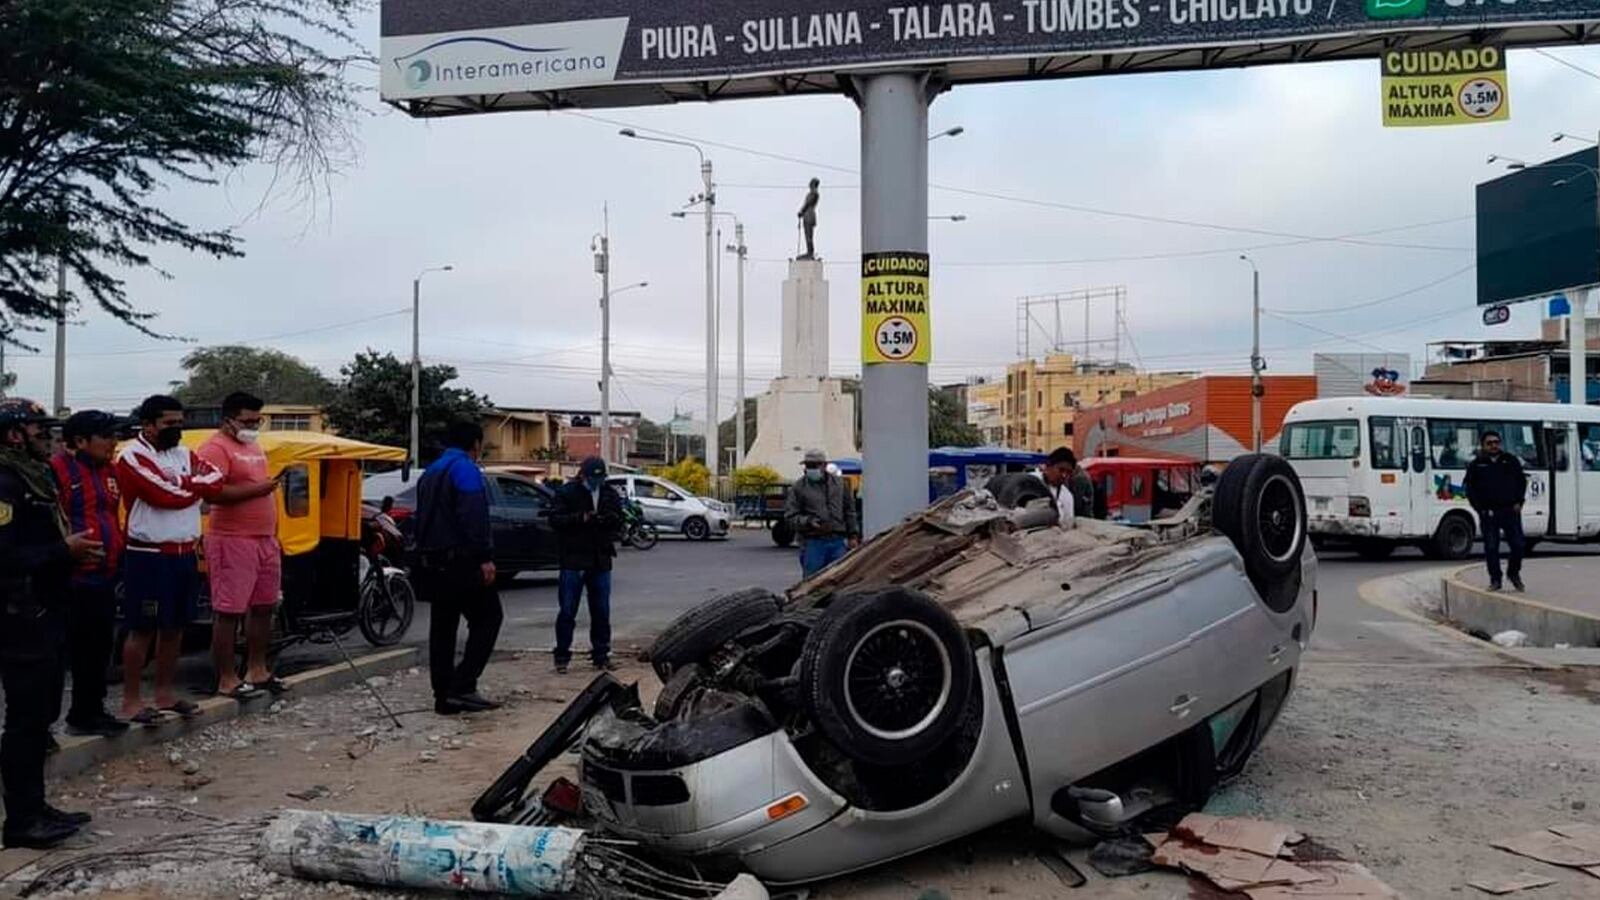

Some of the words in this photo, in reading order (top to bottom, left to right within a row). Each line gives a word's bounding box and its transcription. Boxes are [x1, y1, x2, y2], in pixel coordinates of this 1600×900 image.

[641, 24, 718, 60] PIURA
[742, 11, 863, 54] SULLANA
[888, 2, 996, 41] TALARA
[1022, 0, 1140, 34] TUMBES
[435, 54, 606, 81] Interamericana
[1387, 46, 1498, 73] CUIDADO
[1389, 84, 1454, 99] ALTURA
[1463, 90, 1498, 105] 3.5M
[1388, 101, 1456, 118] MÁXIMA
[864, 257, 928, 274] ¡CUIDADO!
[867, 281, 925, 296] ALTURA
[880, 331, 914, 345] 3.5M
